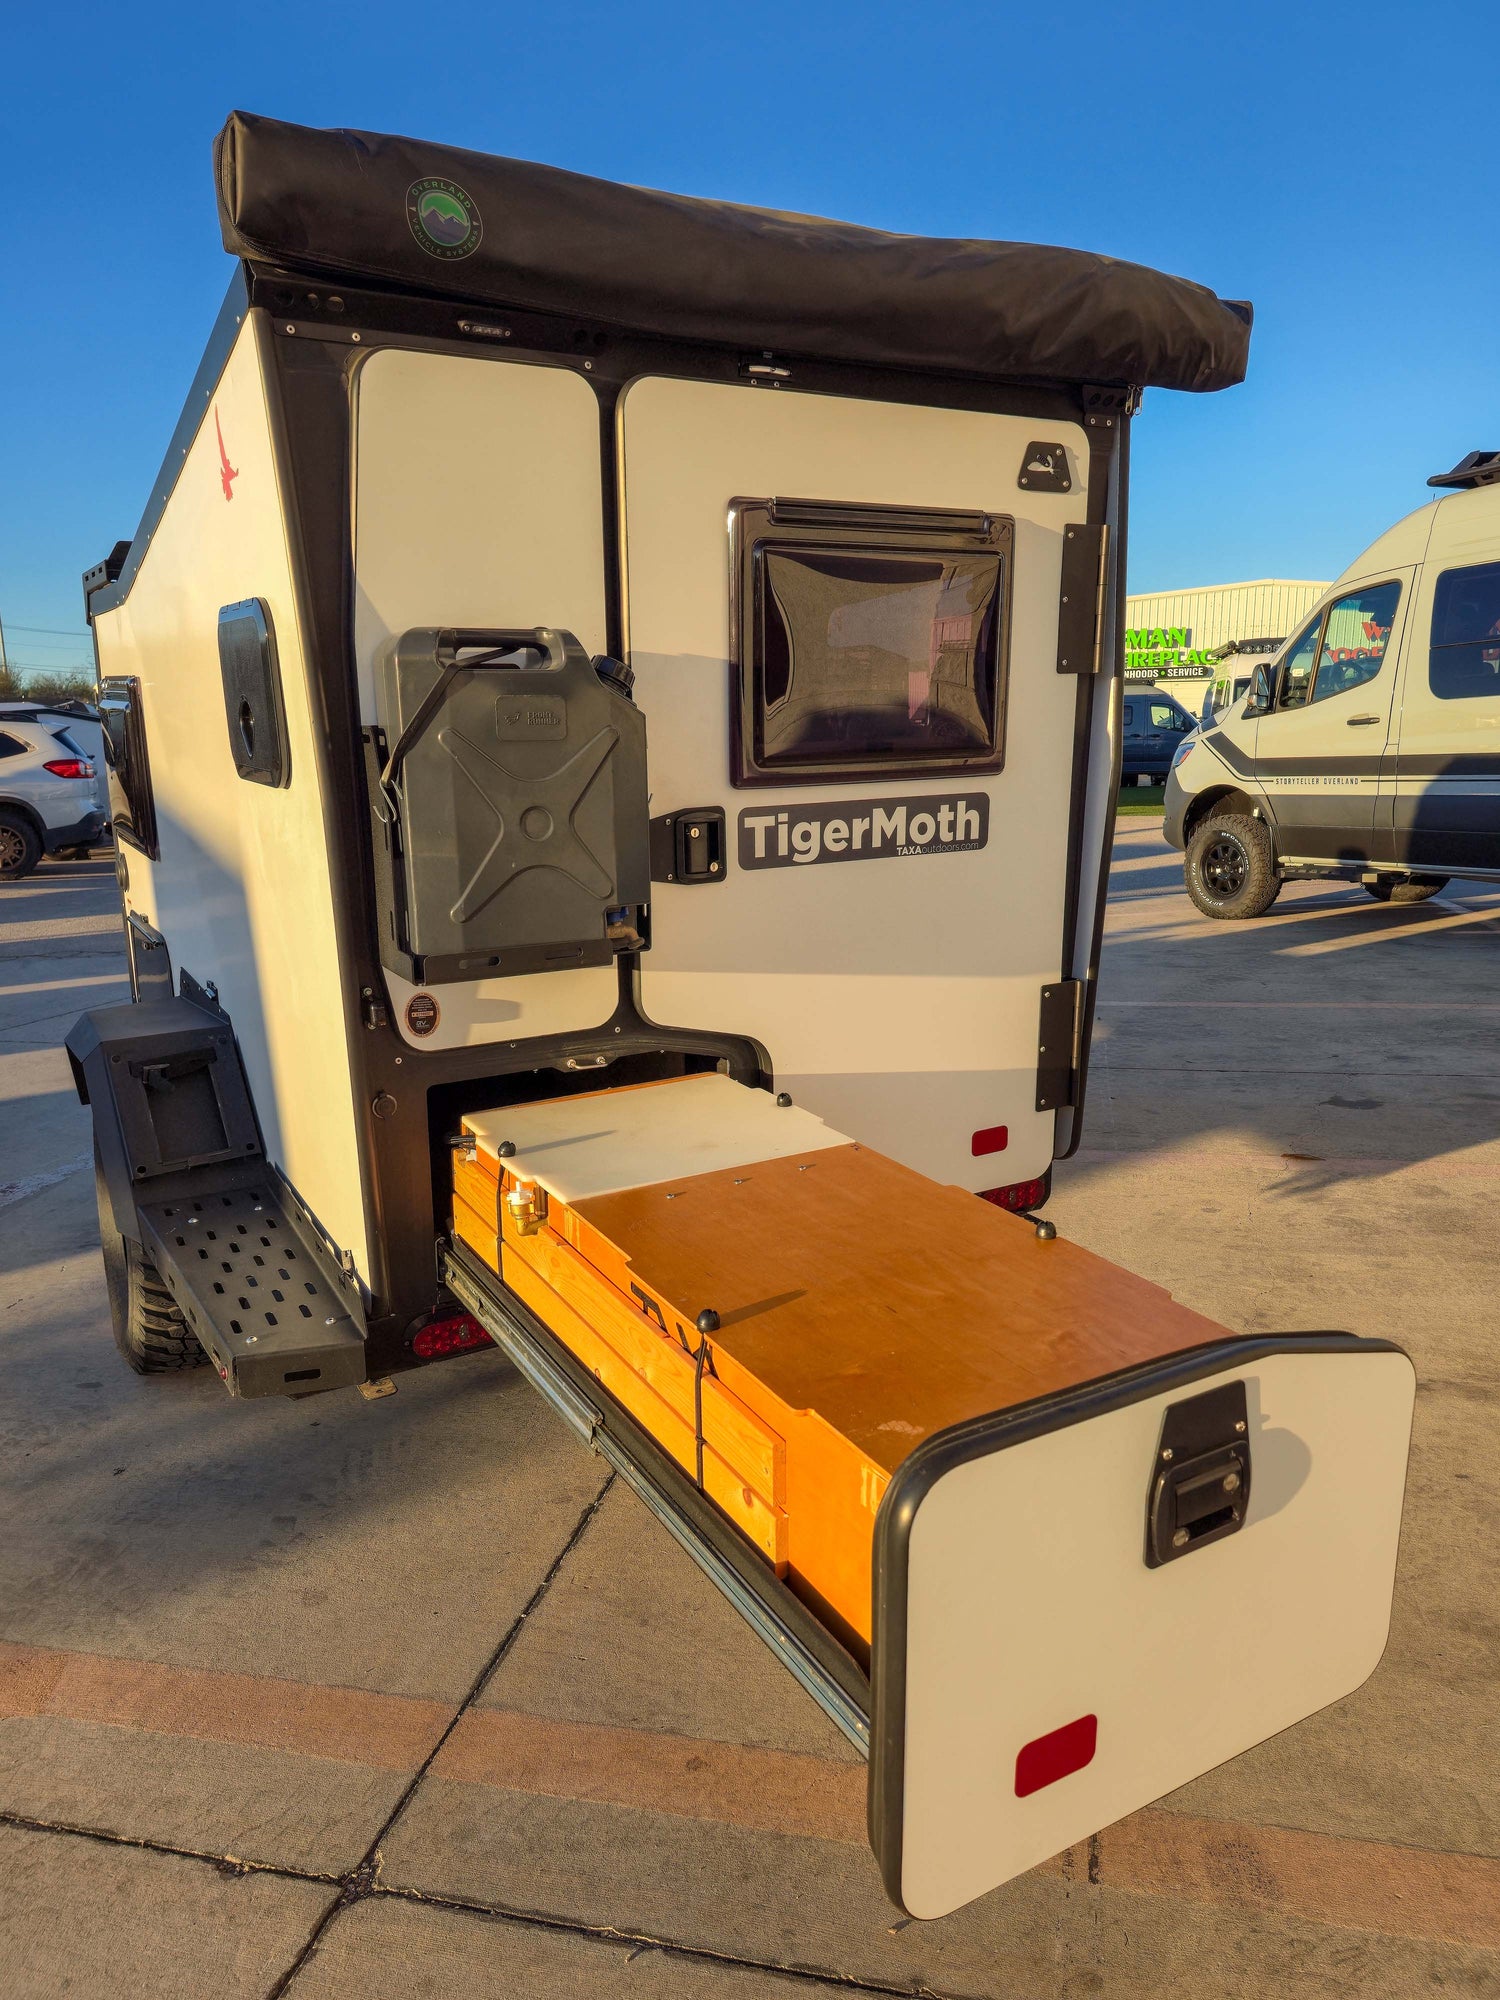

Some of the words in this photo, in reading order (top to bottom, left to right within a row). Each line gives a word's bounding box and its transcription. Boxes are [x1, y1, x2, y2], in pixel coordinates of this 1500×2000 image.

[411, 181, 471, 208] OVERLAND
[412, 218, 442, 255] VEHICLE
[446, 230, 478, 257] SYSTEMS
[1126, 627, 1187, 649] MAN
[1126, 648, 1217, 668] IREPLAC
[1167, 667, 1204, 677] SERVICE
[743, 800, 981, 863] TigerMoth
[896, 842, 979, 856] TAXAoutdoors.com
